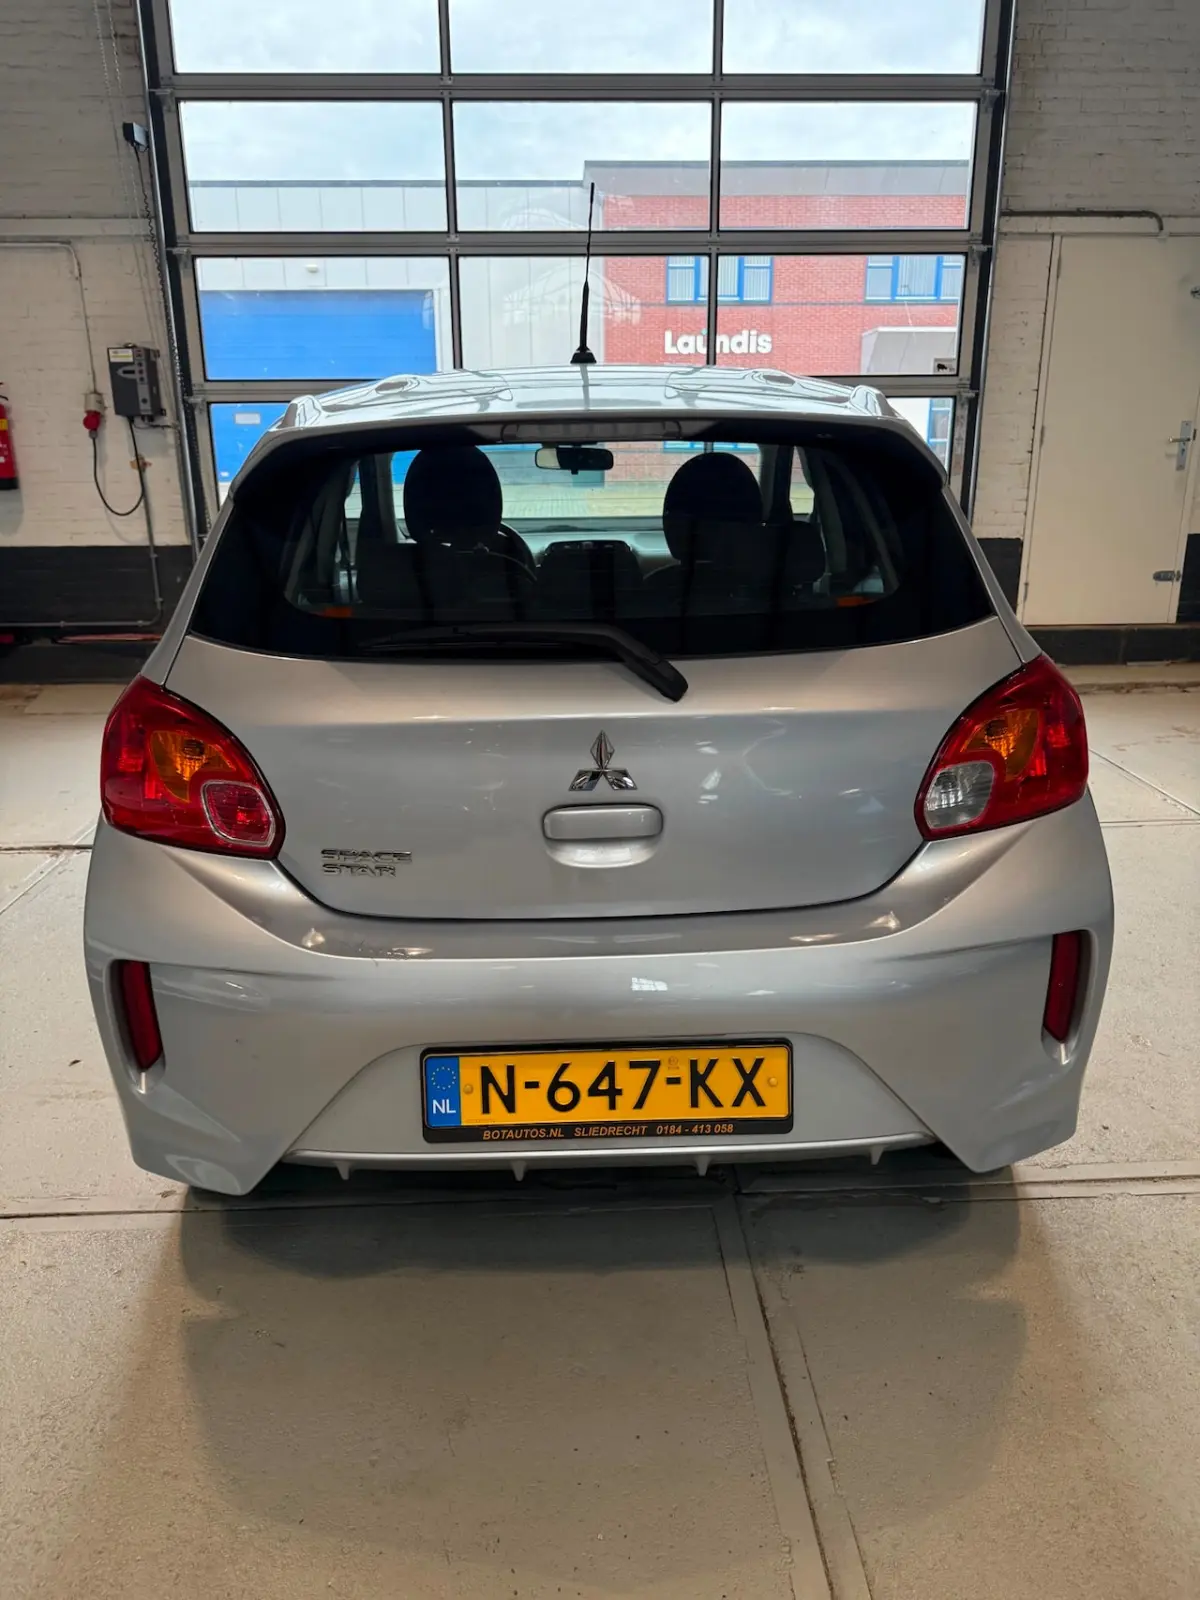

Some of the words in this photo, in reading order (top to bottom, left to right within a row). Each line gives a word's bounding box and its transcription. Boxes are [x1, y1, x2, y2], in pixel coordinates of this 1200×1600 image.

[322, 863, 396, 877] STAR
[480, 1057, 767, 1115] N-647-KX
[432, 1098, 457, 1114] NL
[482, 1127, 565, 1140] BOTAUTOS.NL
[573, 1125, 649, 1137] SLIEDRECHT
[656, 1124, 682, 1135] 0184
[691, 1124, 712, 1134] 413
[713, 1123, 734, 1134] 058
